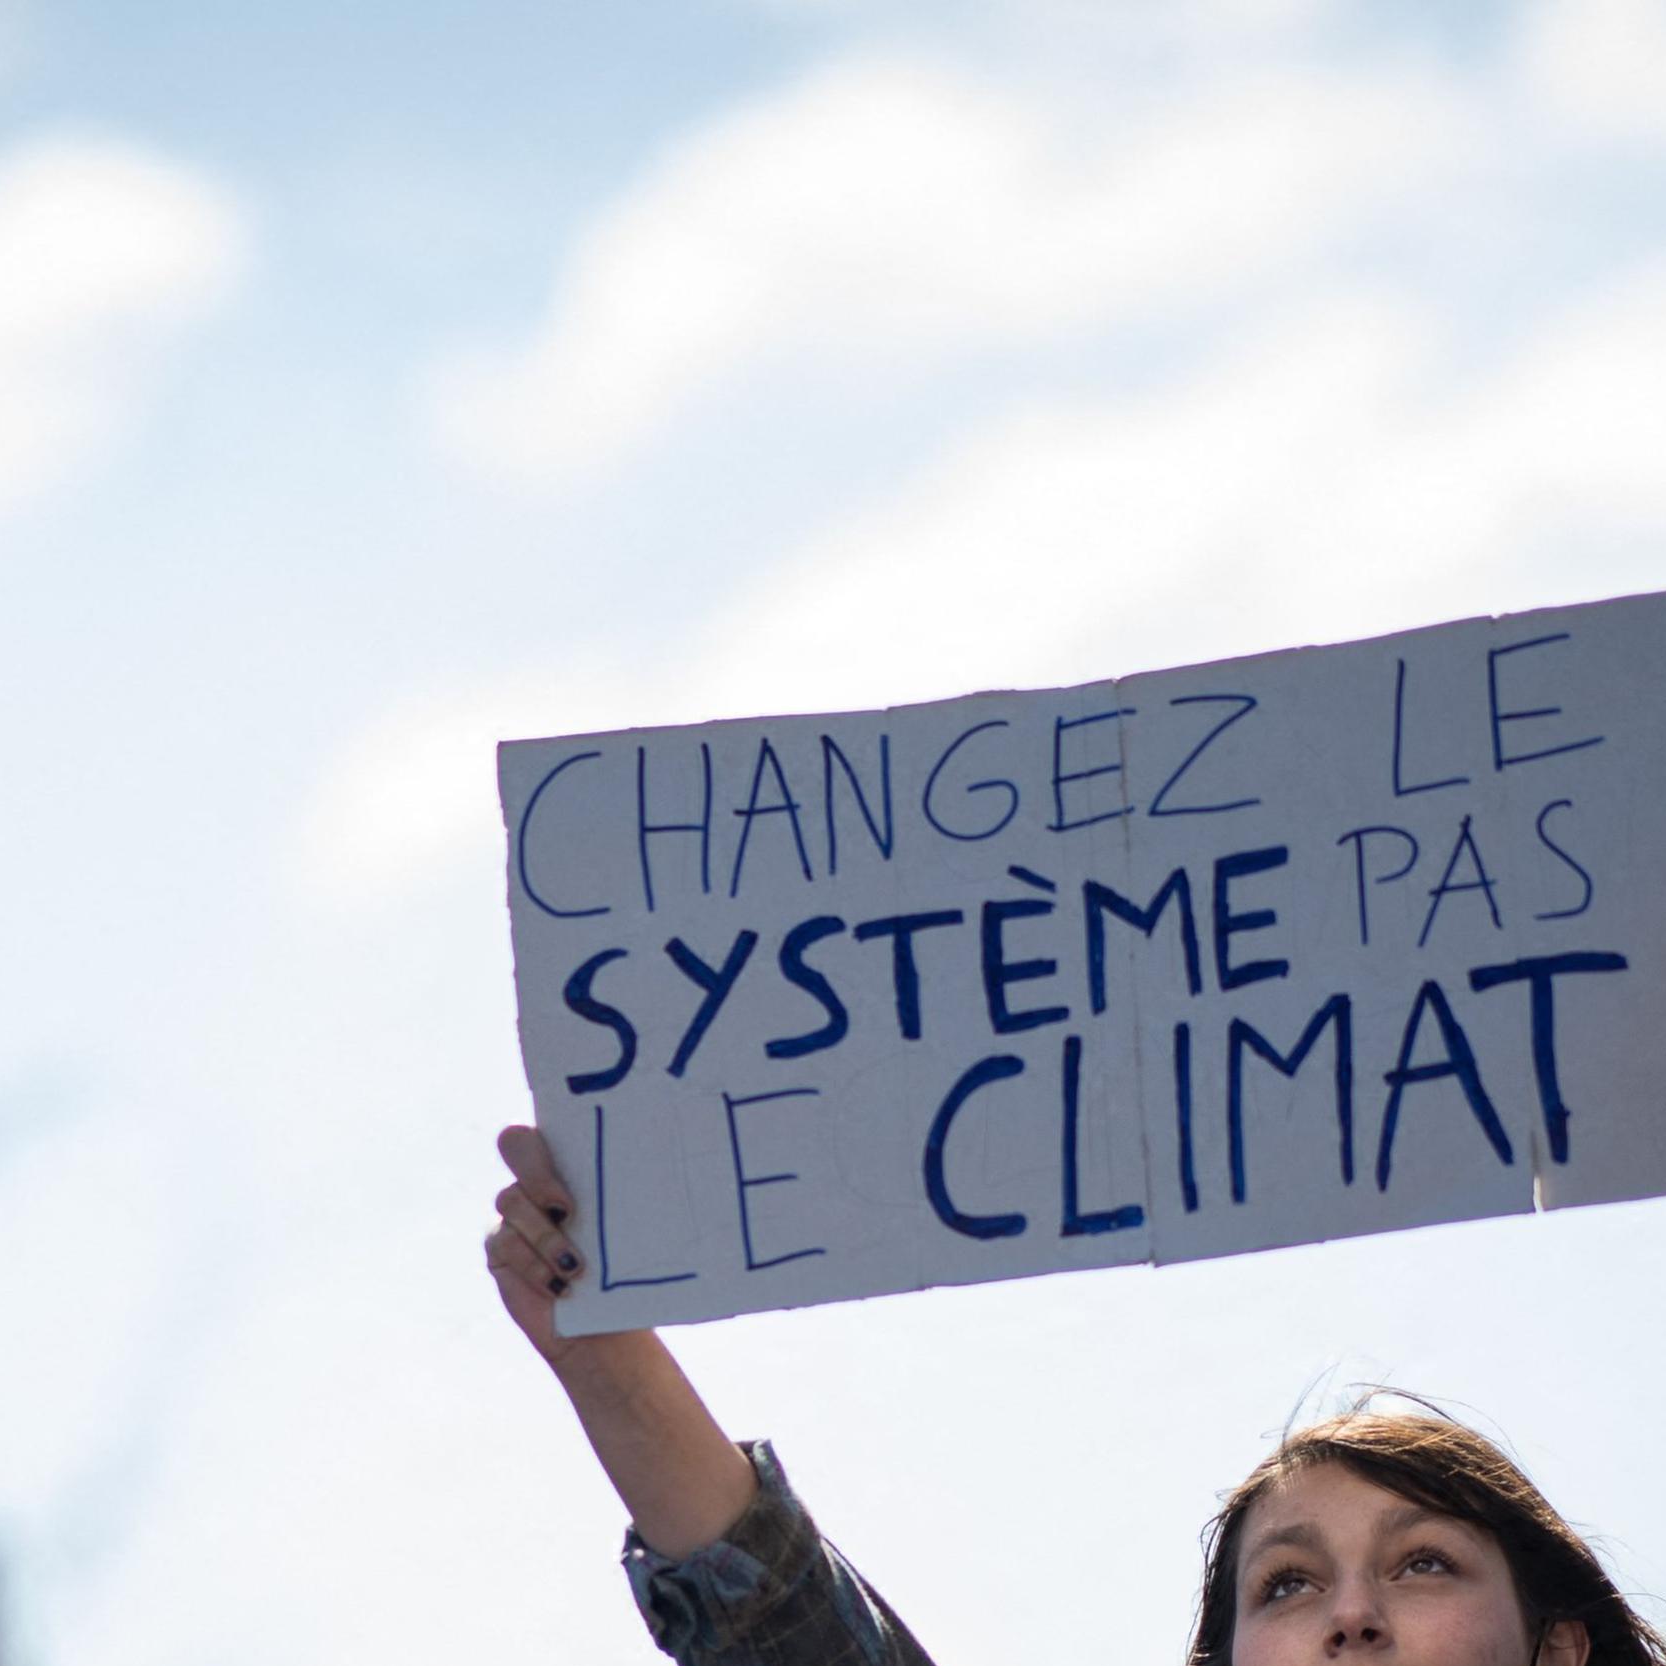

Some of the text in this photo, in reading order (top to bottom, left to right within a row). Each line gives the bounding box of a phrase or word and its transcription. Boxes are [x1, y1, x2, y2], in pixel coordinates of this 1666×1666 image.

[518, 632, 1605, 917] CHANGEZ LE
[562, 799, 1595, 1095] SYSTÈME PAS
[593, 951, 1629, 1291] LE CLIMAT
